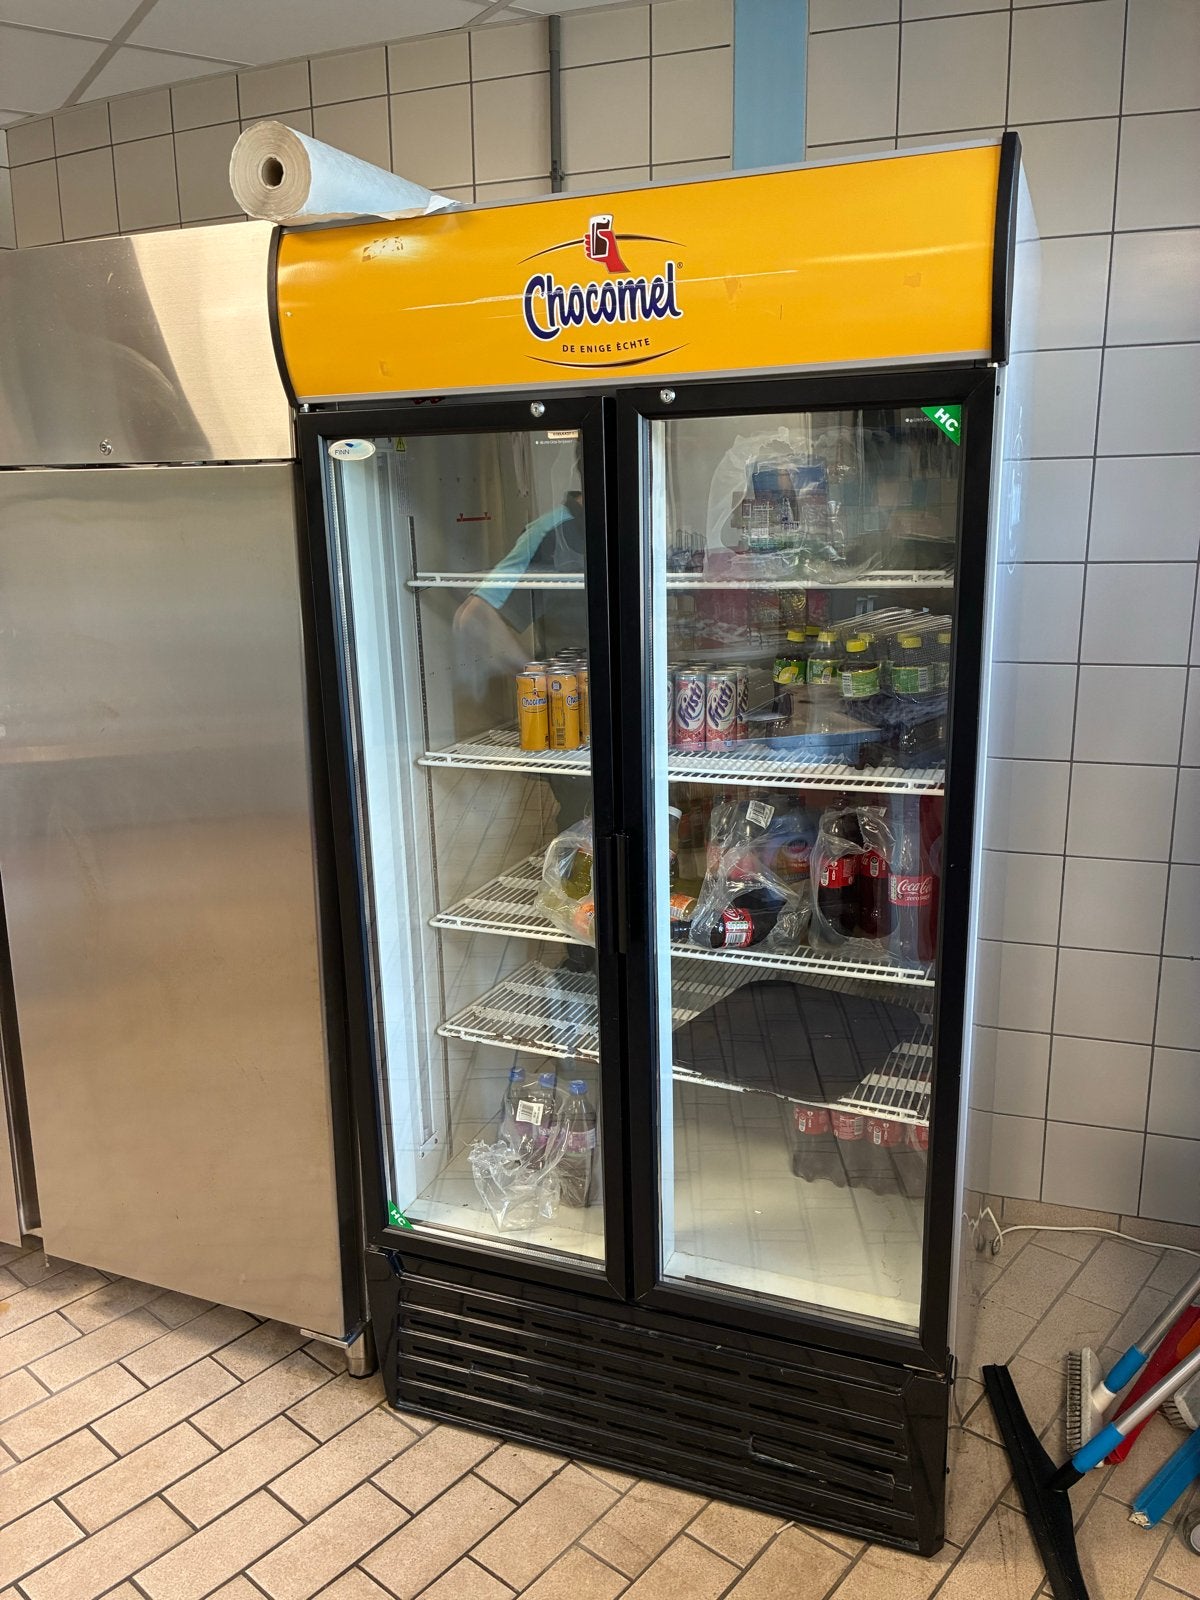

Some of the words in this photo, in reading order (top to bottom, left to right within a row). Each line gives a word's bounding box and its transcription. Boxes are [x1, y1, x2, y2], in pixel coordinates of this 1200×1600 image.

[523, 261, 683, 342] Chocomel
[562, 344, 576, 353] DE
[580, 343, 612, 353] ENIGE
[934, 407, 959, 432] HC
[677, 678, 704, 729] Fristi
[707, 679, 734, 729] Fristi
[390, 1209, 406, 1226] HC
